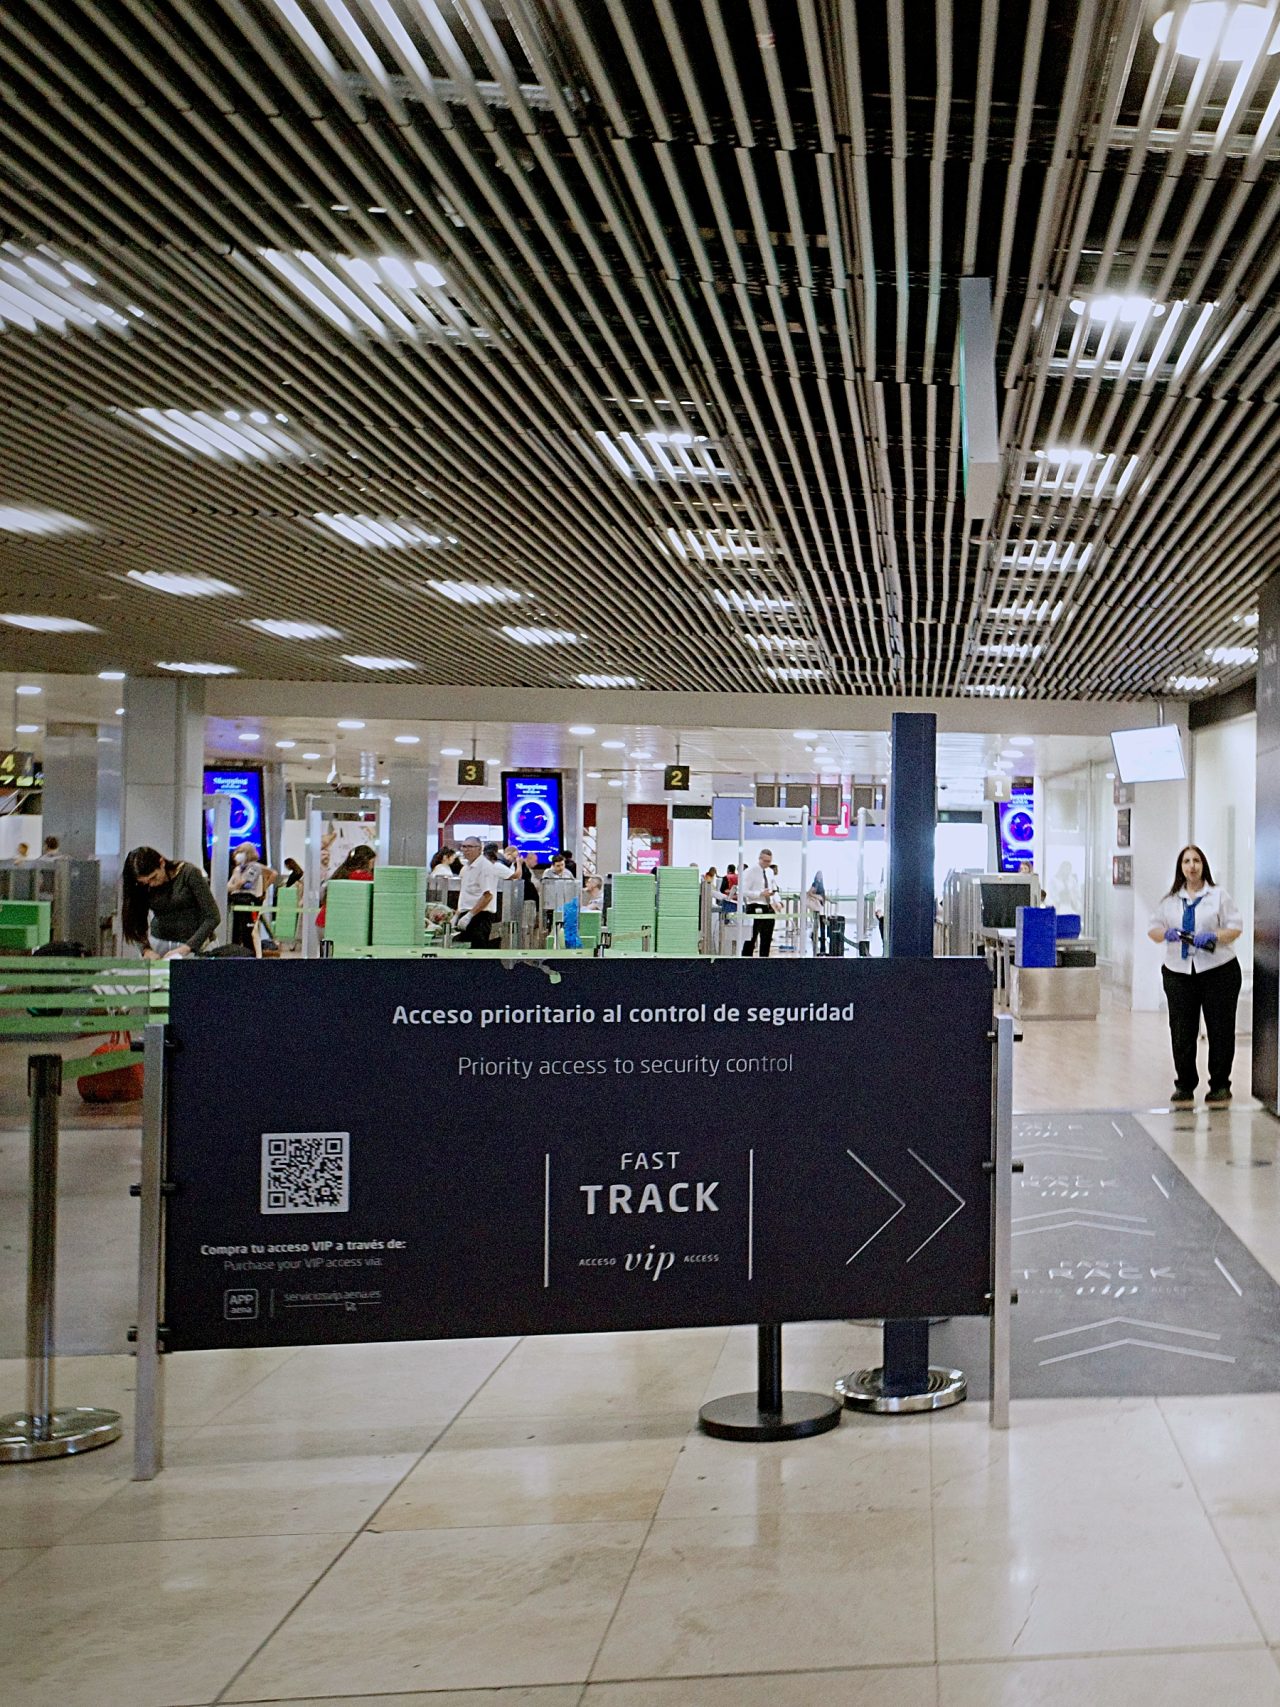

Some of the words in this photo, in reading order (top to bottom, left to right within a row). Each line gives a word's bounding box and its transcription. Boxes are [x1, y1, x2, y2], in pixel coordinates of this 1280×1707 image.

[0, 753, 15, 773] 4
[464, 765, 477, 781] 3
[670, 771, 683, 786] 2
[994, 780, 1004, 797] 1
[392, 1005, 473, 1025] Acceso
[480, 1004, 596, 1028] prioritario
[602, 1004, 622, 1023] al
[629, 1004, 706, 1023] control
[713, 1004, 740, 1022] de
[747, 1003, 855, 1026] seguridad
[458, 1057, 533, 1080] Priority
[539, 1059, 607, 1075] access
[613, 1058, 634, 1074] to
[640, 1055, 720, 1077] security
[726, 1054, 793, 1073] control
[621, 1151, 681, 1170] FAST
[579, 1182, 720, 1215] TRACK
[200, 1244, 248, 1257] Compra
[251, 1244, 265, 1254] tu
[267, 1243, 310, 1253] acceso
[312, 1241, 334, 1252] VIP
[336, 1242, 344, 1251] a
[347, 1239, 385, 1250] través
[386, 1239, 407, 1249] de:
[224, 1260, 276, 1271] Purchase
[277, 1261, 301, 1272] your
[304, 1257, 324, 1268] VIP
[325, 1257, 362, 1267] access
[578, 1258, 617, 1267] ACCESO
[624, 1244, 676, 1282] vip
[683, 1254, 720, 1263] ACCESS
[230, 1294, 254, 1305] APP
